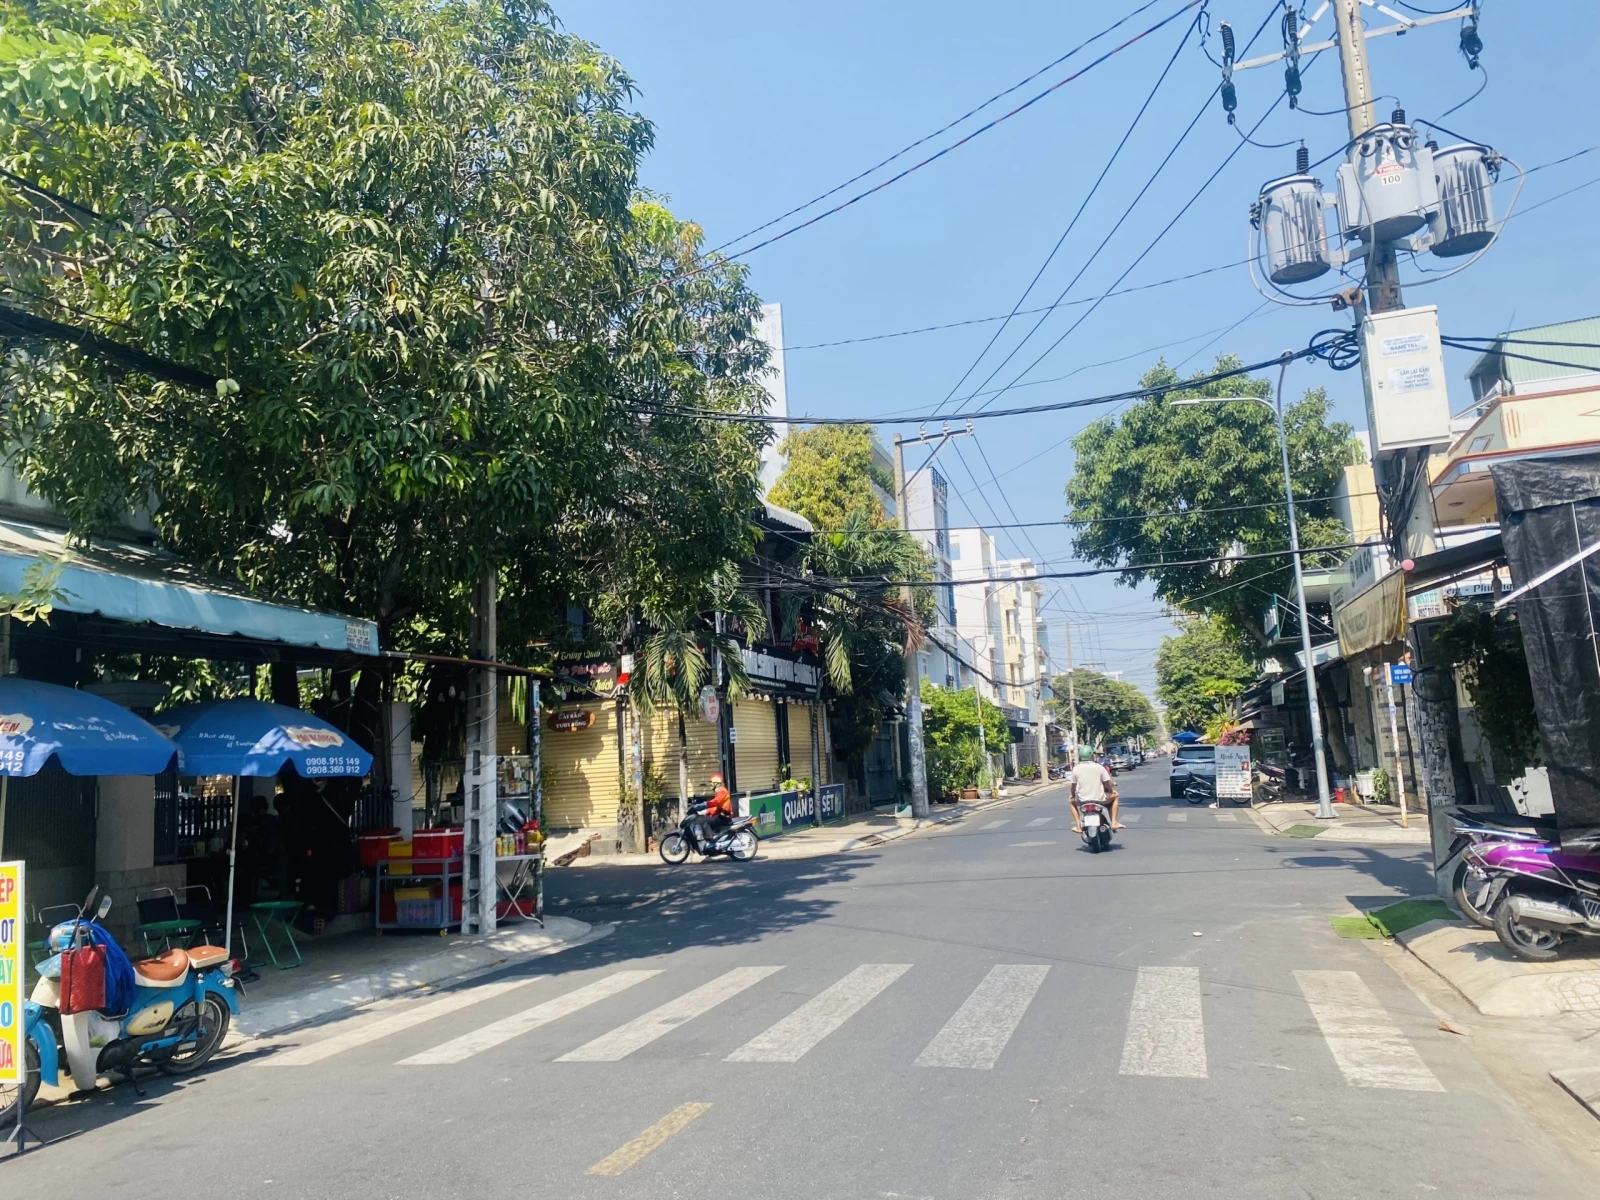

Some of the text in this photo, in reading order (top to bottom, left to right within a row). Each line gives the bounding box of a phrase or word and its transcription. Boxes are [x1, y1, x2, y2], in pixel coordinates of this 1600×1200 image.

[1383, 174, 1401, 185] 100
[306, 757, 360, 766] 0908.915 149
[306, 765, 360, 774] 0908.360 912
